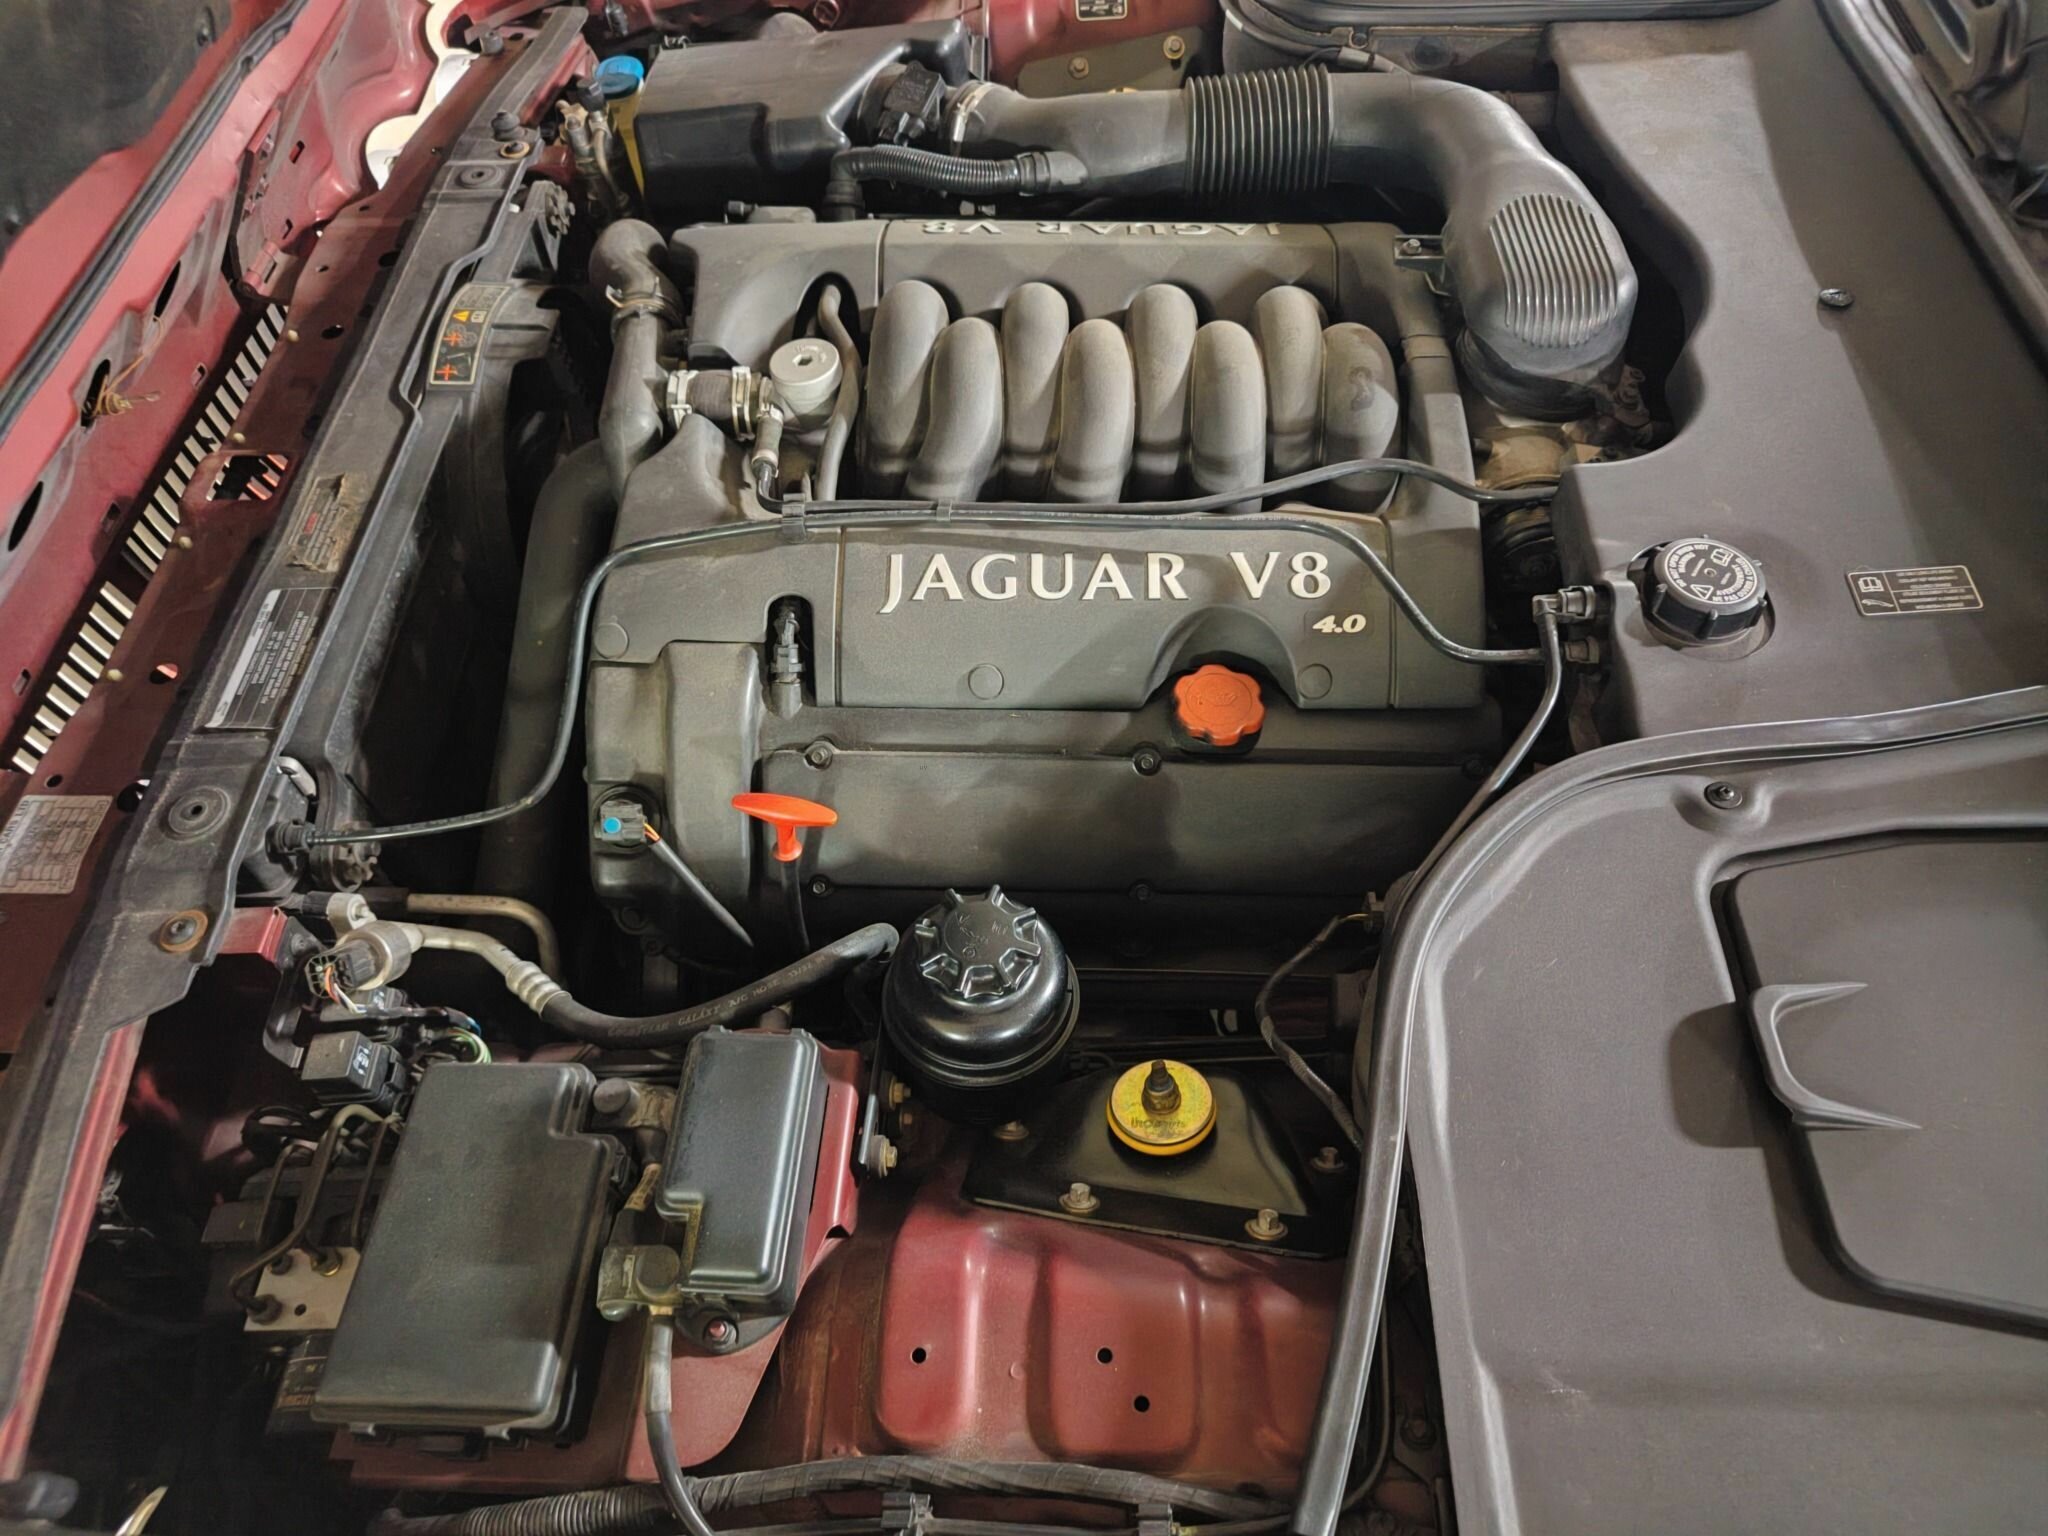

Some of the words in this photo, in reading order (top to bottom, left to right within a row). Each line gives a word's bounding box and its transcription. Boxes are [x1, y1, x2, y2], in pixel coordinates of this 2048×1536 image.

[922, 221, 1002, 236] V8
[877, 552, 1189, 614] JAGUAR
[1229, 551, 1332, 599] V8
[1312, 613, 1367, 634] 4.0
